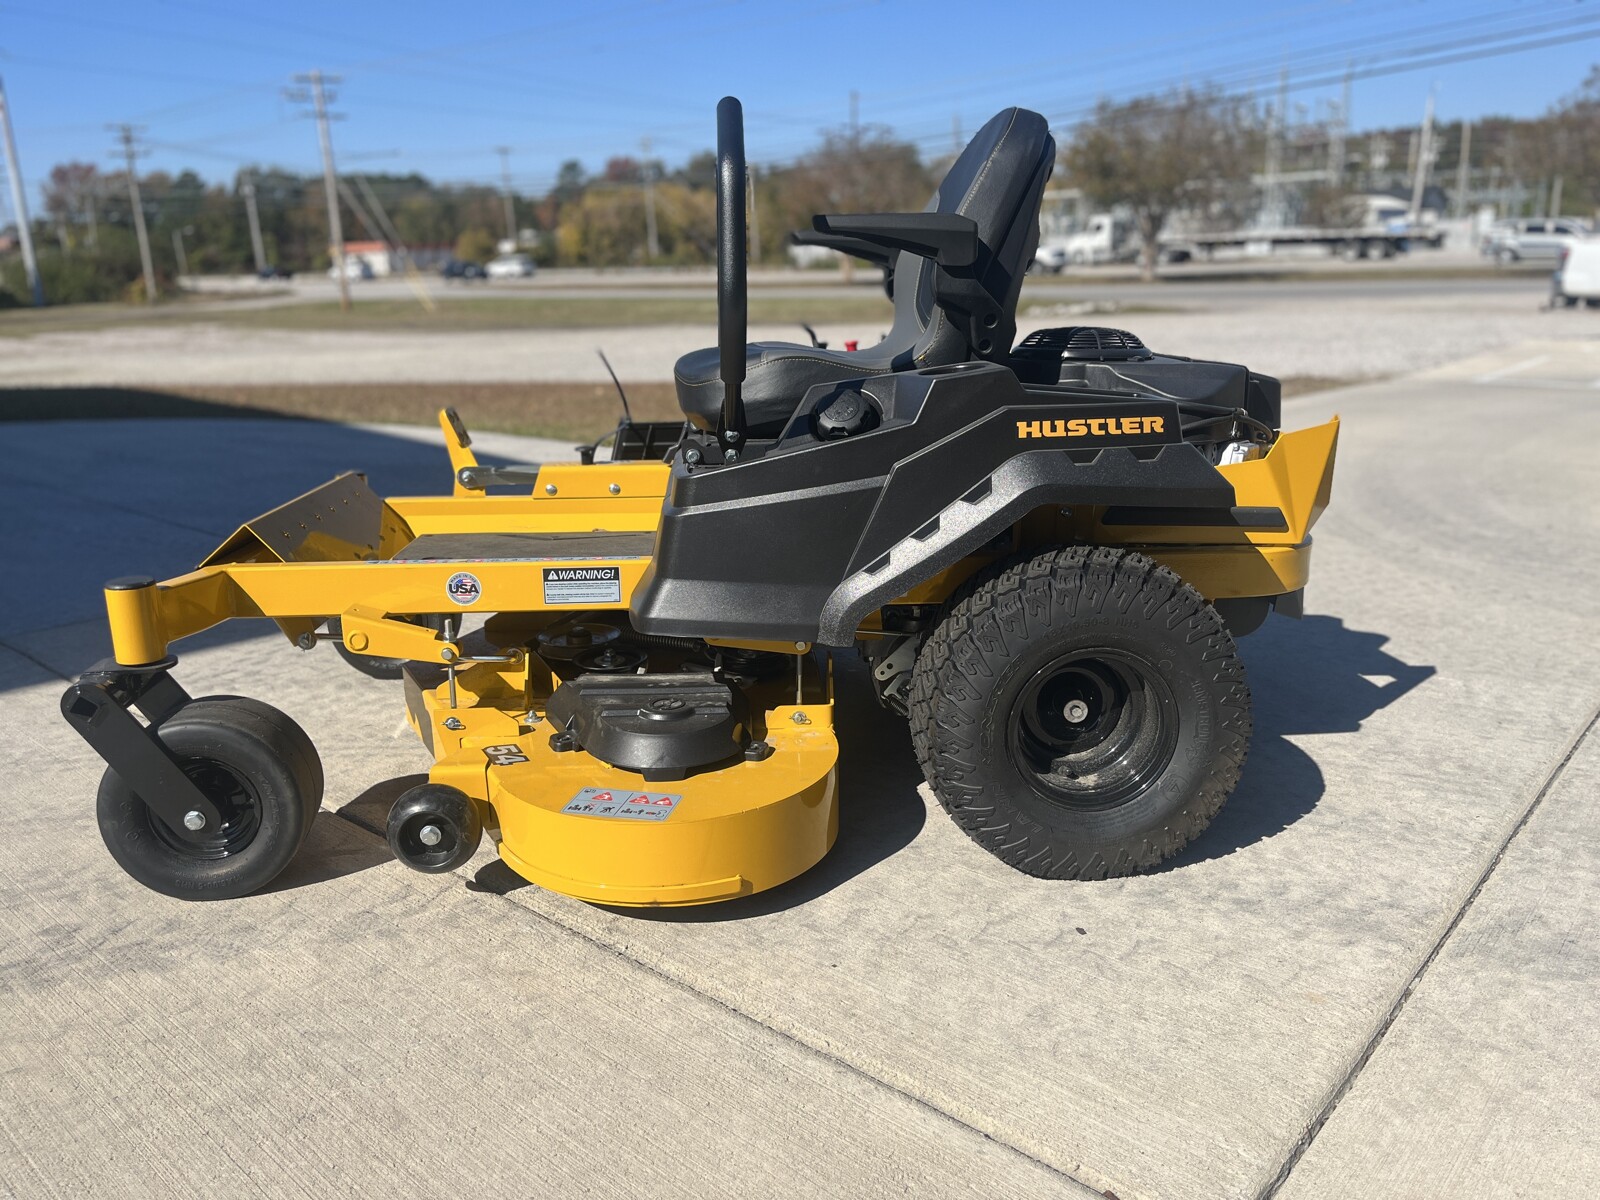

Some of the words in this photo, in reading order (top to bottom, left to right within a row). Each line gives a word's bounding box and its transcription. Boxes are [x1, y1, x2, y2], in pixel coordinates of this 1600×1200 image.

[1016, 416, 1164, 439] HUSTLER
[558, 569, 615, 580] WARNING!
[448, 583, 480, 594] USA
[486, 745, 526, 765] 54
